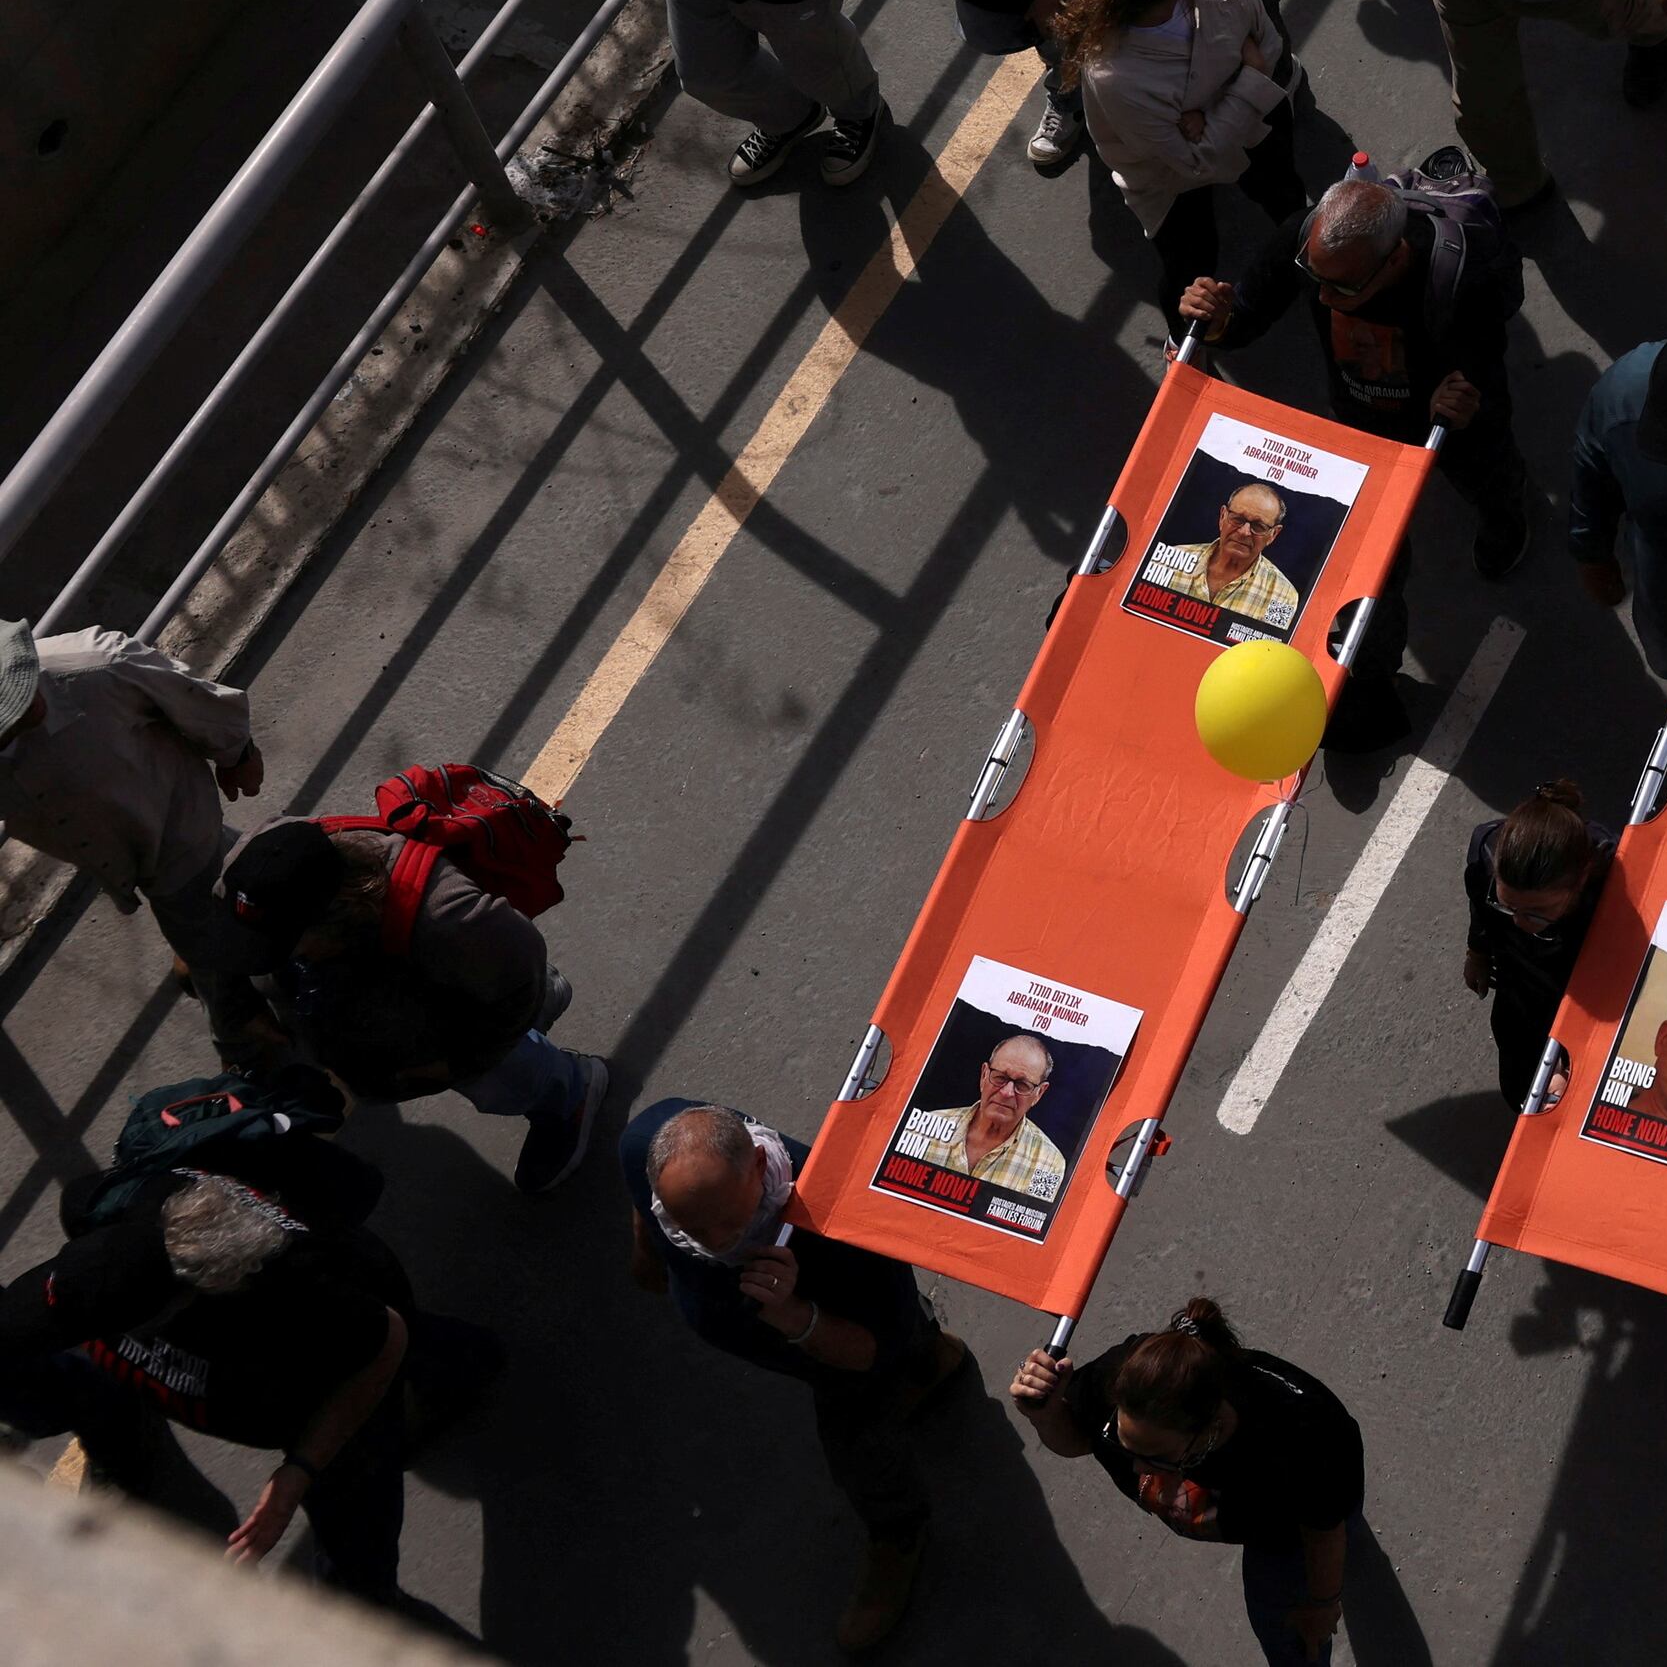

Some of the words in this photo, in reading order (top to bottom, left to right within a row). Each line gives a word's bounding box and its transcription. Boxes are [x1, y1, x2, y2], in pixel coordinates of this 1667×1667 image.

[1364, 385, 1411, 398] AVRAHAM
[1263, 437, 1285, 455] מונדר
[1284, 444, 1312, 462] אברהם
[1243, 445, 1285, 467] ABRAHAM
[1285, 459, 1319, 479] MUNDER
[1266, 466, 1284, 481] (78)
[1151, 542, 1198, 574] BRING
[1142, 562, 1174, 587] HIM
[1132, 584, 1174, 610] HOME
[1175, 597, 1221, 628] NOW!
[1028, 981, 1052, 1000] מונדר
[1051, 989, 1082, 1009] אברהם
[1007, 991, 1053, 1015] ABRAHAM
[1052, 1004, 1089, 1026] MUNDER
[1031, 1013, 1053, 1031] (78)
[1609, 1056, 1657, 1090] BRING
[1600, 1078, 1634, 1108] HIM
[905, 1108, 957, 1143] BRING
[1592, 1105, 1635, 1135] HOME
[895, 1132, 931, 1159] HIM
[883, 1156, 931, 1186] HOME
[932, 1171, 980, 1204] NOW!
[986, 1204, 1020, 1223] FAMILIES
[1016, 1213, 1044, 1232] FORUM
